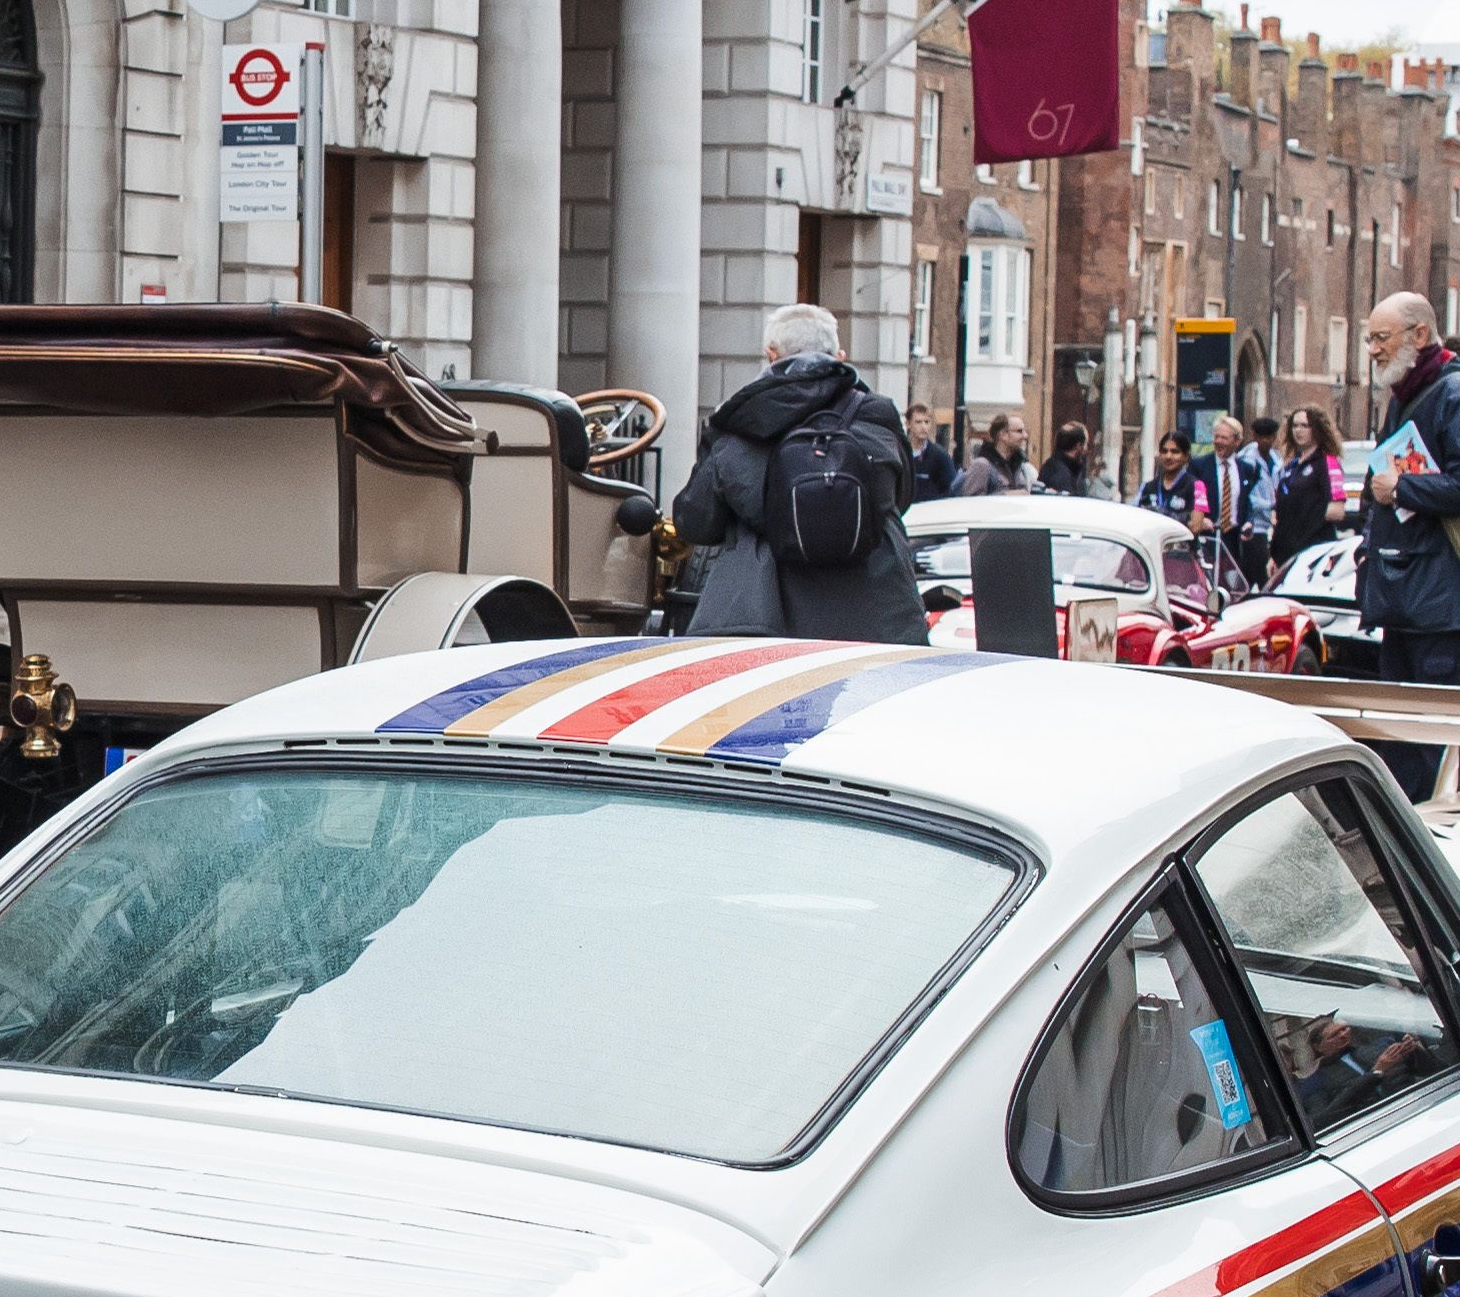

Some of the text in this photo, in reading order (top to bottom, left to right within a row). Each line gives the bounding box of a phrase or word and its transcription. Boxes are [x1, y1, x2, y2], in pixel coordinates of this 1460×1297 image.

[1027, 98, 1075, 146] 67
[228, 180, 255, 188] London
[255, 180, 269, 189] City
[242, 204, 269, 214] Original
[271, 204, 287, 212] Tour
